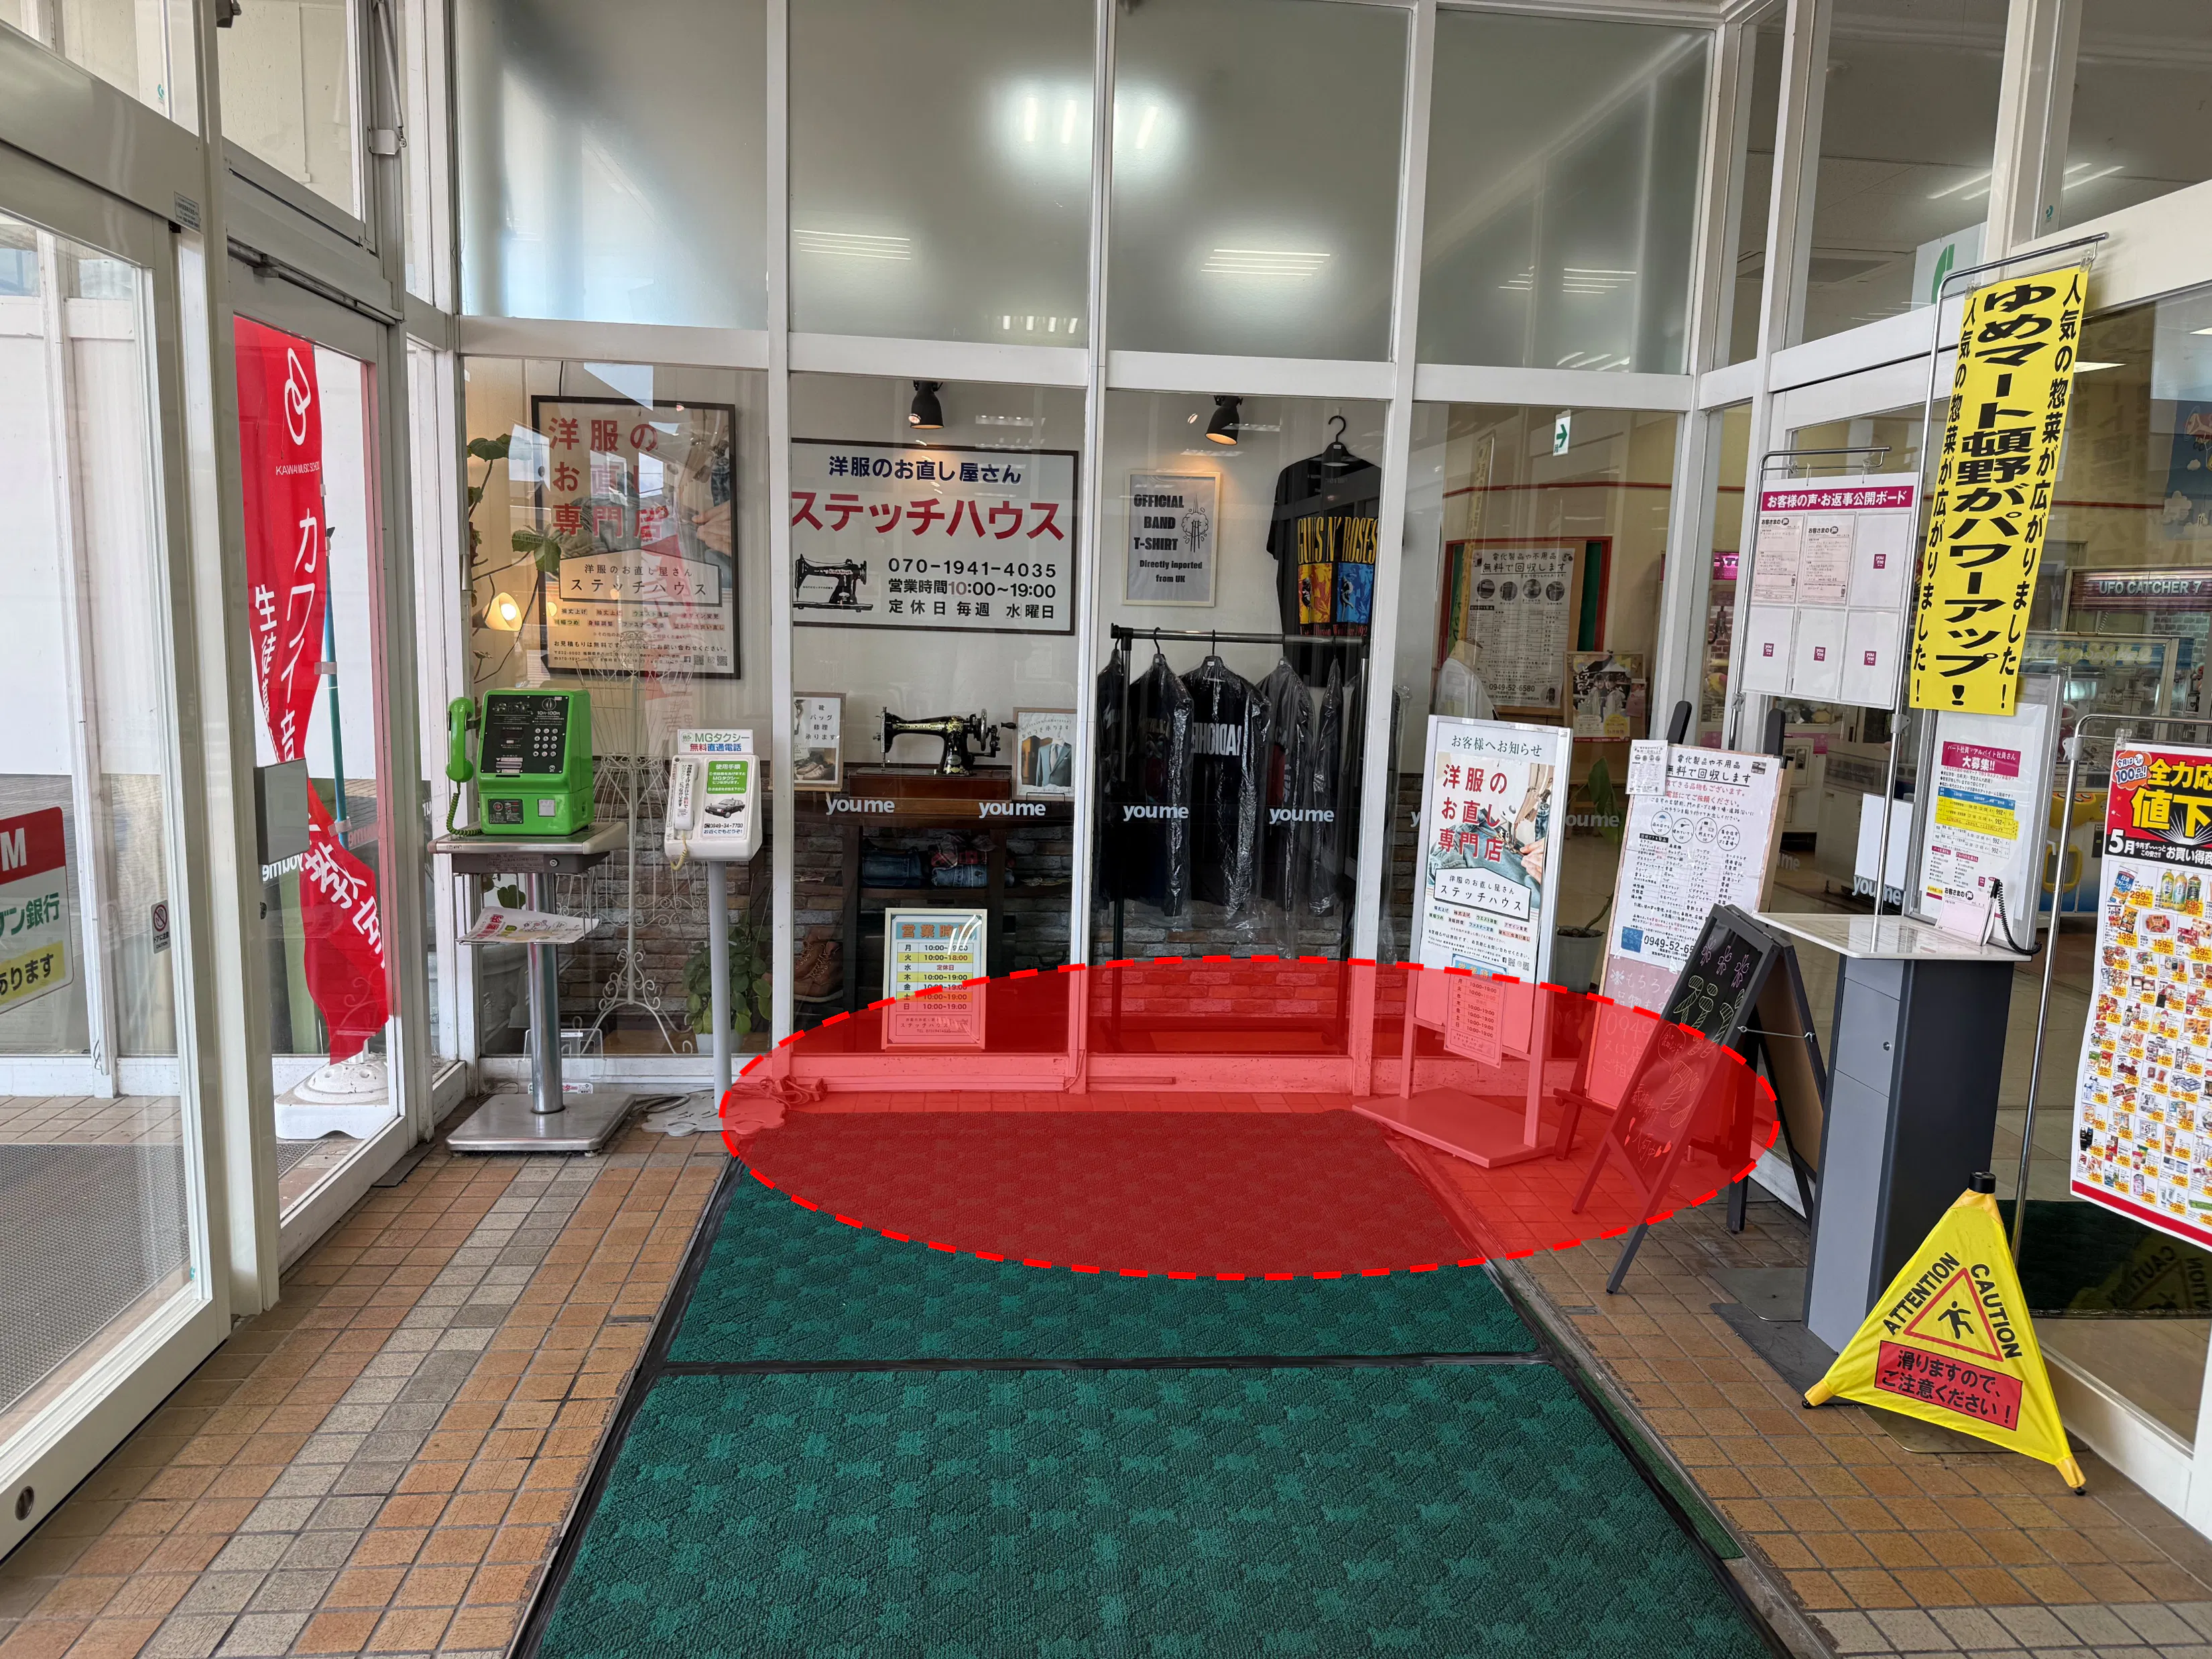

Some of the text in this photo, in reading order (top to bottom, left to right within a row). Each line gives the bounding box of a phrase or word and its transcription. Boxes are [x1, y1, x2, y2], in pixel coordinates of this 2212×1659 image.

[548, 418, 658, 452] 洋服の
[828, 456, 1022, 484] 洋服のお直し屋さん
[1768, 491, 1907, 508] お客様の声・お返事公開ボード
[1913, 298, 1977, 702] 人気の惣菜が広がりました!
[1936, 284, 2056, 705] ゆめマート頓野がパワーアップ!
[2000, 274, 2082, 709] 人気の惣菜が広がりました!
[1133, 494, 1184, 508] OFFICIAL
[792, 491, 1064, 540] ステッチハウス
[1144, 516, 1176, 529] BAND
[1134, 537, 1178, 550] T-SHIRT
[1298, 517, 1324, 564] GUNS
[1342, 517, 1379, 564] ROSES
[585, 564, 692, 577] 洋服のお直し屋さん
[888, 558, 1056, 577] 070-1941-4035
[1140, 560, 1169, 570] Directly
[1482, 562, 1566, 573] 無料で回収します
[1156, 574, 1173, 582] from
[571, 579, 706, 596] ステッチハウス
[2099, 580, 2202, 595] UFO CATCHER 7
[694, 733, 750, 743] MGタクシー
[1451, 735, 1542, 757] お客様へお知らせ
[690, 743, 742, 752] 無料直通電話
[1677, 754, 1740, 769] 電化製品や不用品
[1962, 755, 1995, 772] 大募集!!
[2116, 757, 2133, 767] 今月は
[1442, 763, 1508, 794] 洋服の
[1667, 765, 1751, 784] 無料で回収します
[2115, 766, 2147, 784] 100品!
[826, 798, 895, 816] youme
[979, 802, 1046, 819] youme
[1123, 804, 1188, 822] youme
[1442, 797, 1500, 828] お直し
[2132, 787, 2212, 837] 値下
[1269, 808, 1335, 825] youme
[1566, 814, 1620, 828] oume
[1438, 828, 1503, 862] 専門店
[2109, 828, 2135, 855] 5月
[1449, 875, 1515, 894] 洋服のお直し屋さん
[1440, 885, 1521, 911] ステッチハウス
[1883, 1251, 1960, 1336] ATTENTION
[1970, 1264, 2023, 1359] CAUTION
[1897, 1349, 2001, 1398] 滑りますので、
[1882, 1369, 2011, 1424] ご注意ください!
